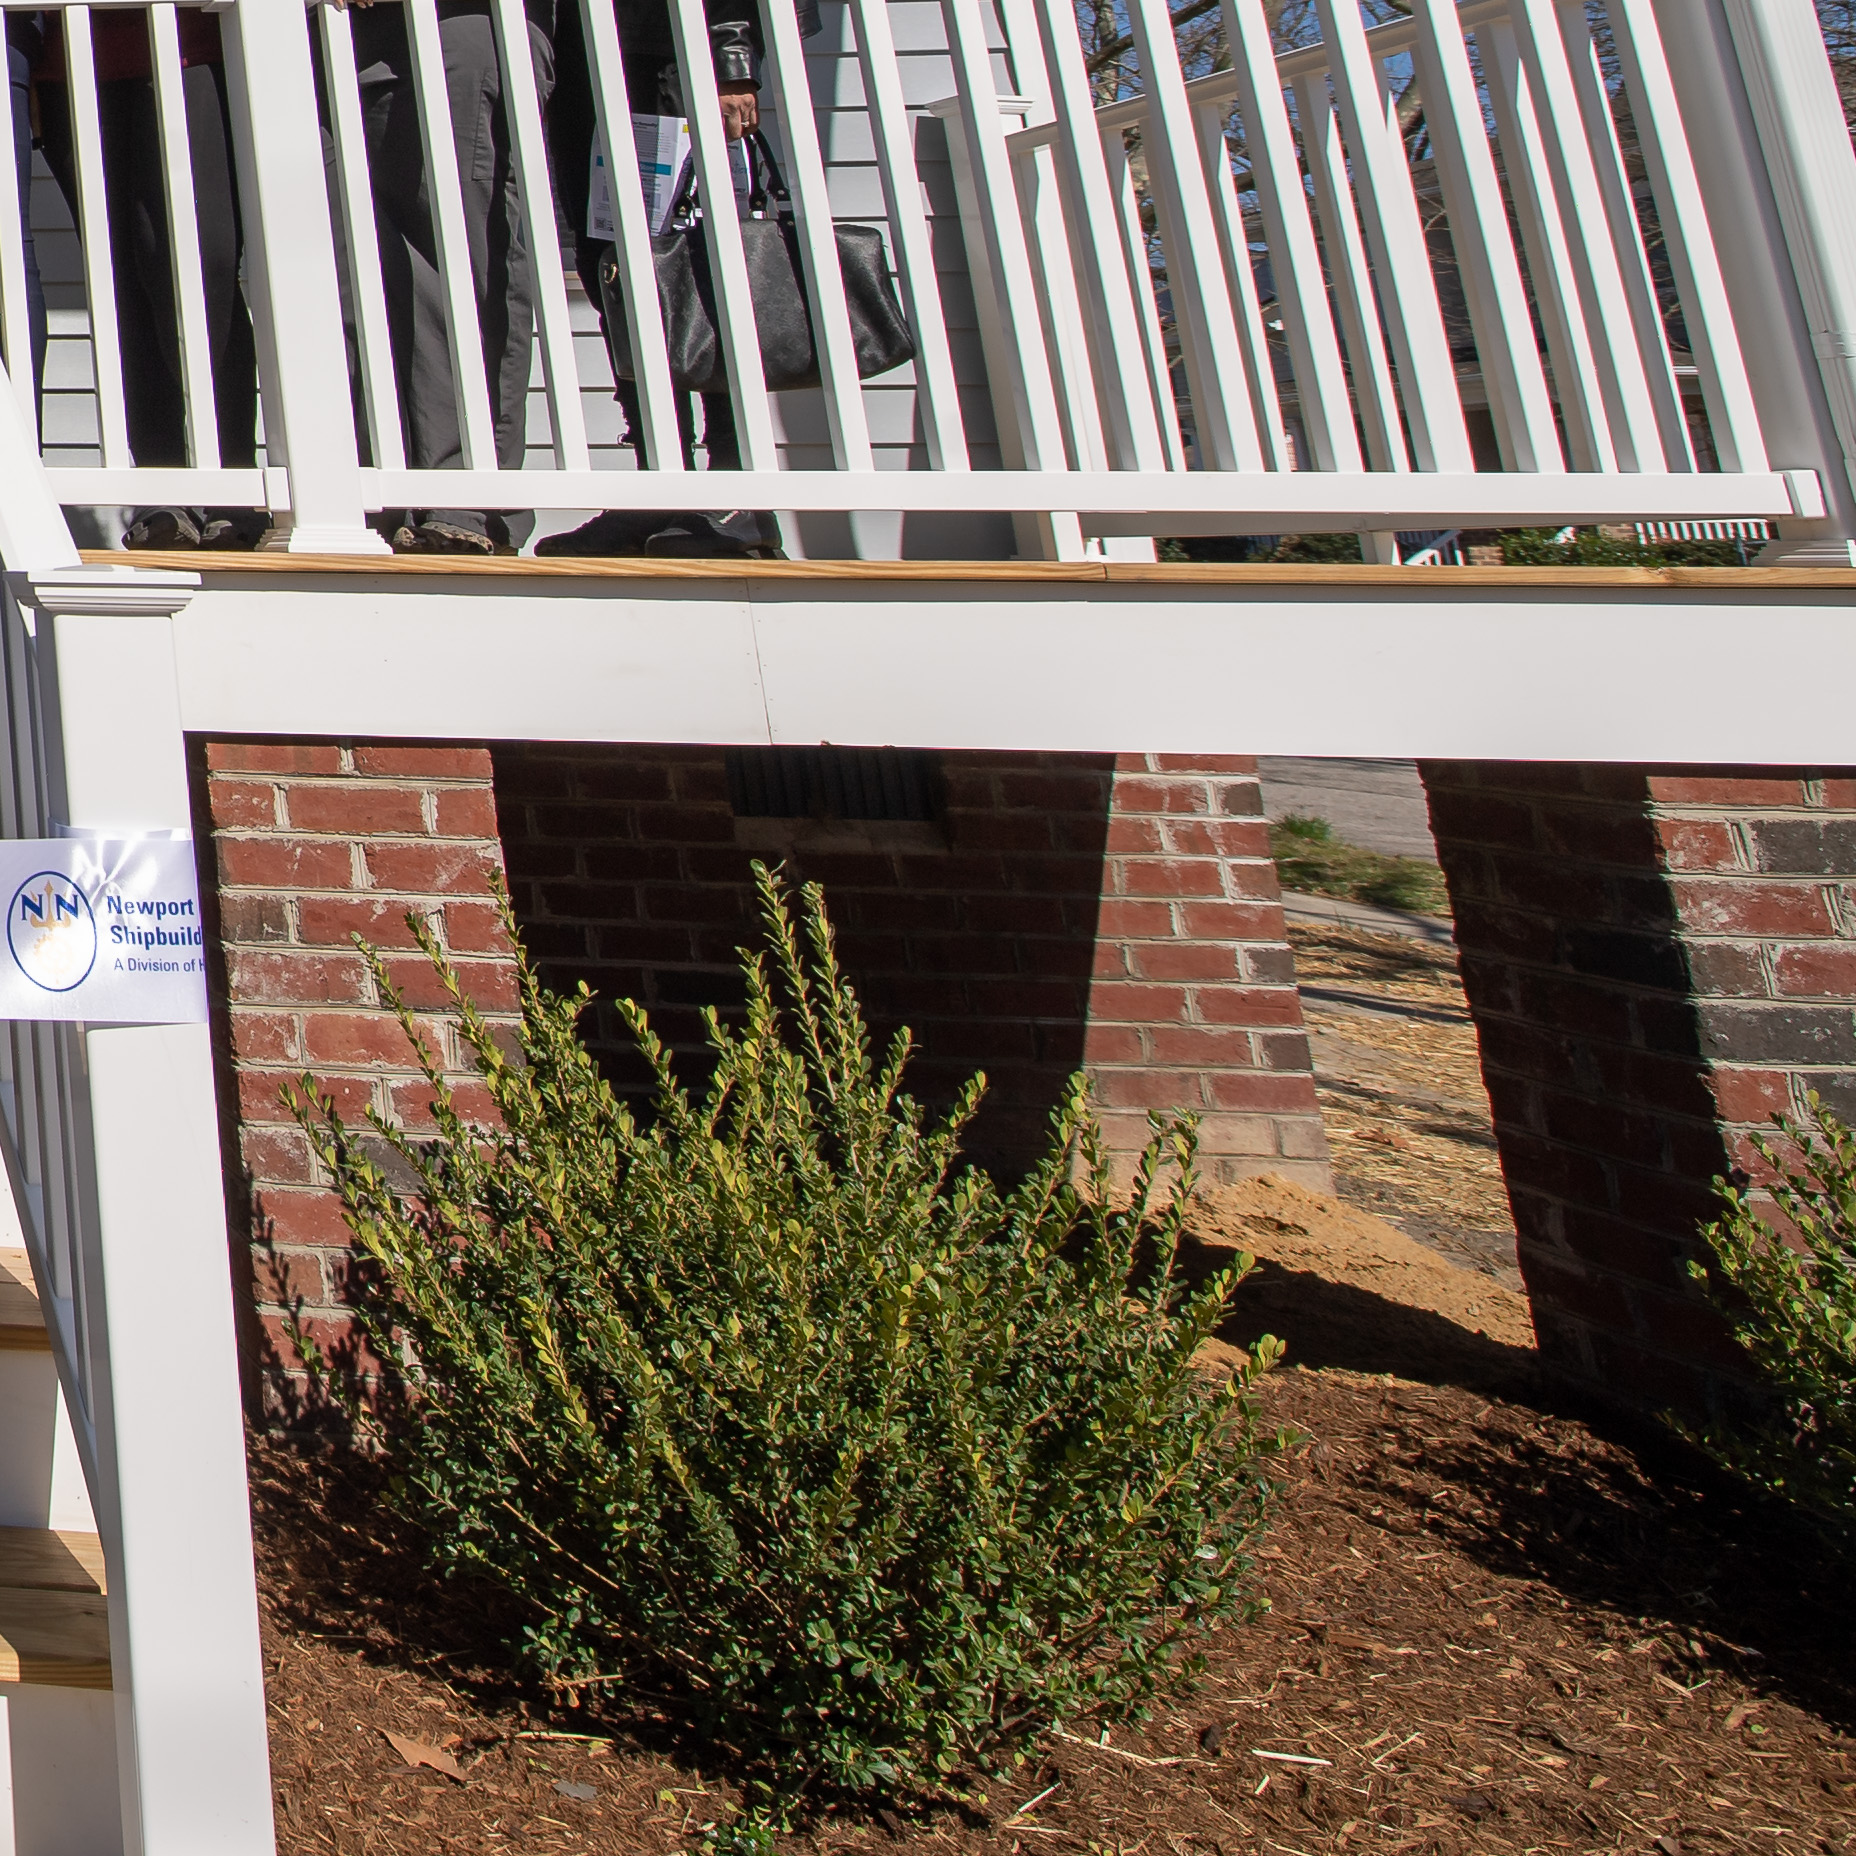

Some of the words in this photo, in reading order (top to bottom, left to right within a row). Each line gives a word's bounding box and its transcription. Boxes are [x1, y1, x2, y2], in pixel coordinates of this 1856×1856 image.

[107, 895, 194, 920] Newport
[114, 958, 124, 971] A
[128, 958, 179, 972] Division
[183, 958, 196, 972] of
